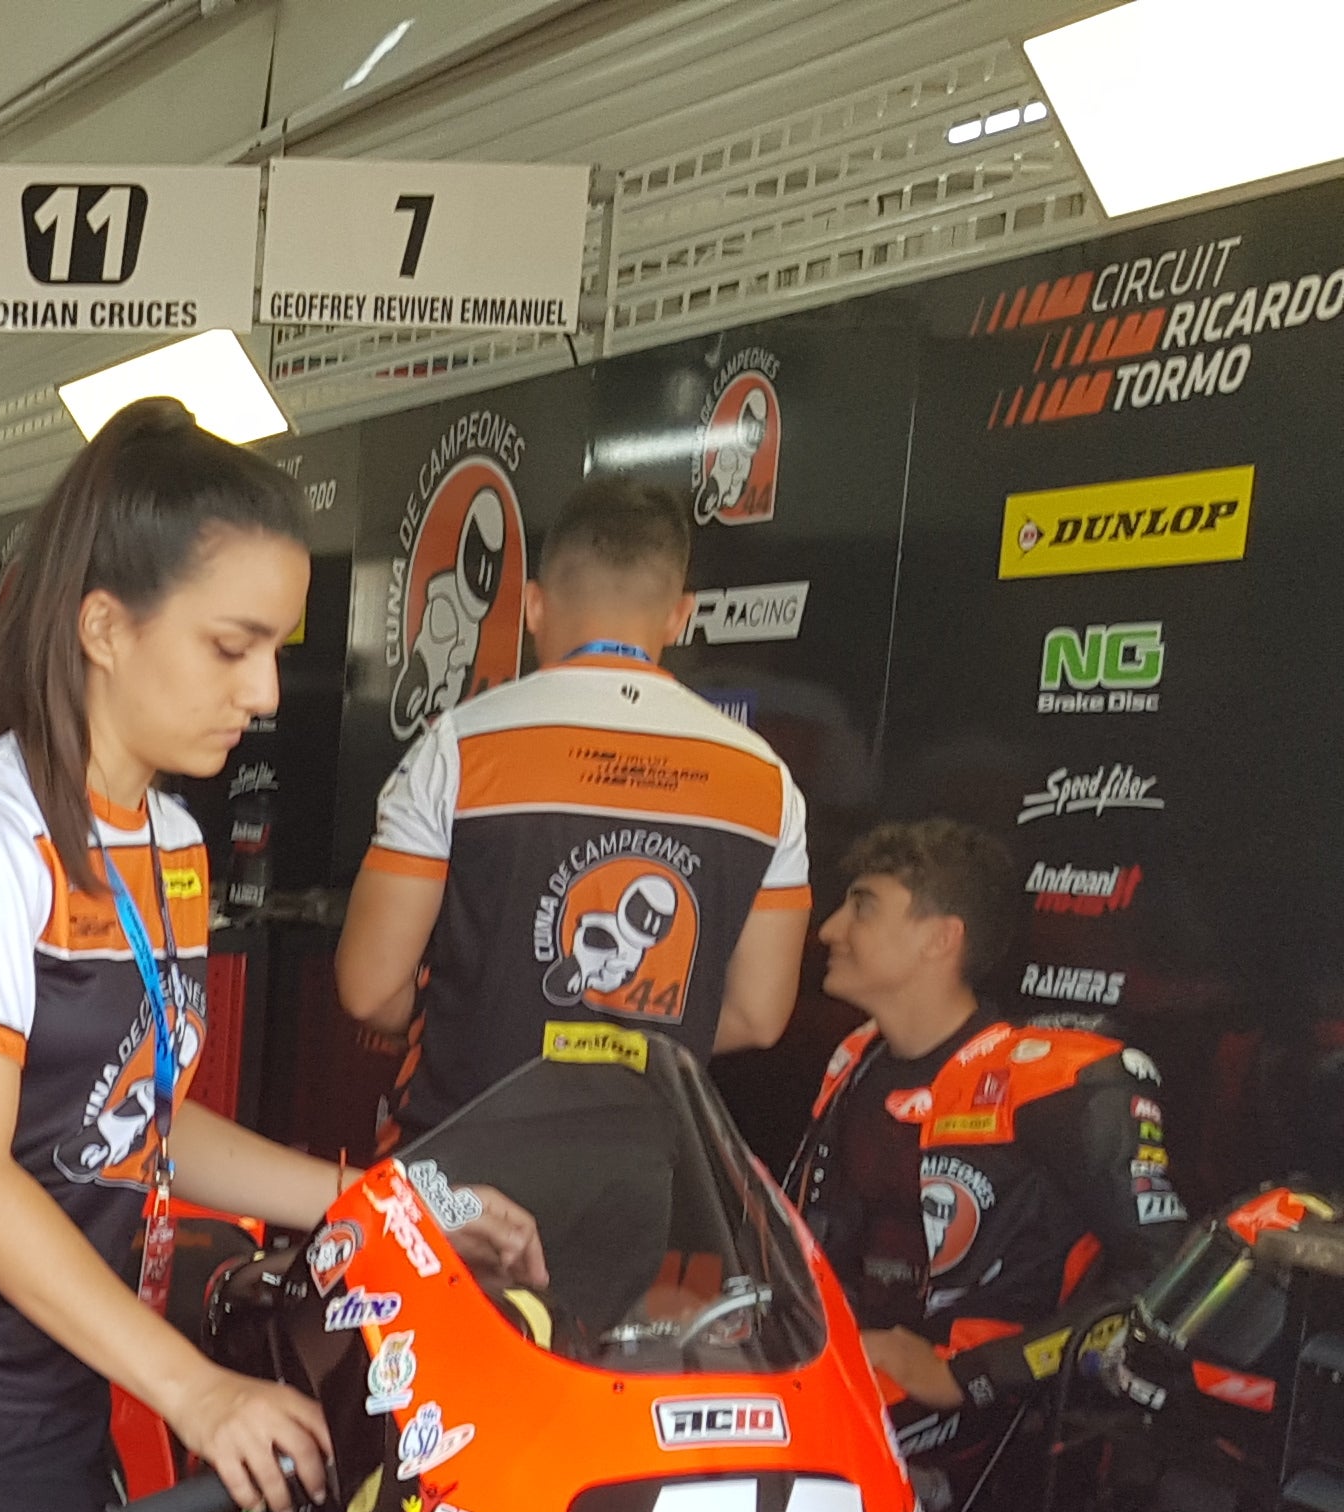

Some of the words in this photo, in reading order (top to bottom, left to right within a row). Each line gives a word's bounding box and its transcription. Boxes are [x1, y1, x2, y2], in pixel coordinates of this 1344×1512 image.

[33, 186, 134, 282] 11
[394, 194, 434, 279] 7
[1092, 236, 1243, 313] CIRCUIT
[89, 301, 197, 328] CRUCES
[270, 292, 366, 322] GEOFFREY
[373, 295, 453, 324] REVIVEN
[460, 297, 567, 327] EMMANUEL
[1161, 268, 1344, 350] RICARDO
[1113, 345, 1252, 411] TORMO
[386, 559, 406, 666] CUNA
[399, 500, 422, 553] DE
[418, 411, 527, 502] CAMPEONES
[1049, 499, 1239, 547] DUNLOP
[723, 599, 799, 630] RACING
[1039, 621, 1164, 691] NG
[1037, 693, 1104, 712] Brake
[1107, 692, 1160, 712] Disc
[536, 895, 559, 962] CUNA
[549, 862, 571, 898] DE
[570, 828, 702, 878] CAMPEONES
[625, 978, 681, 1014] 44
